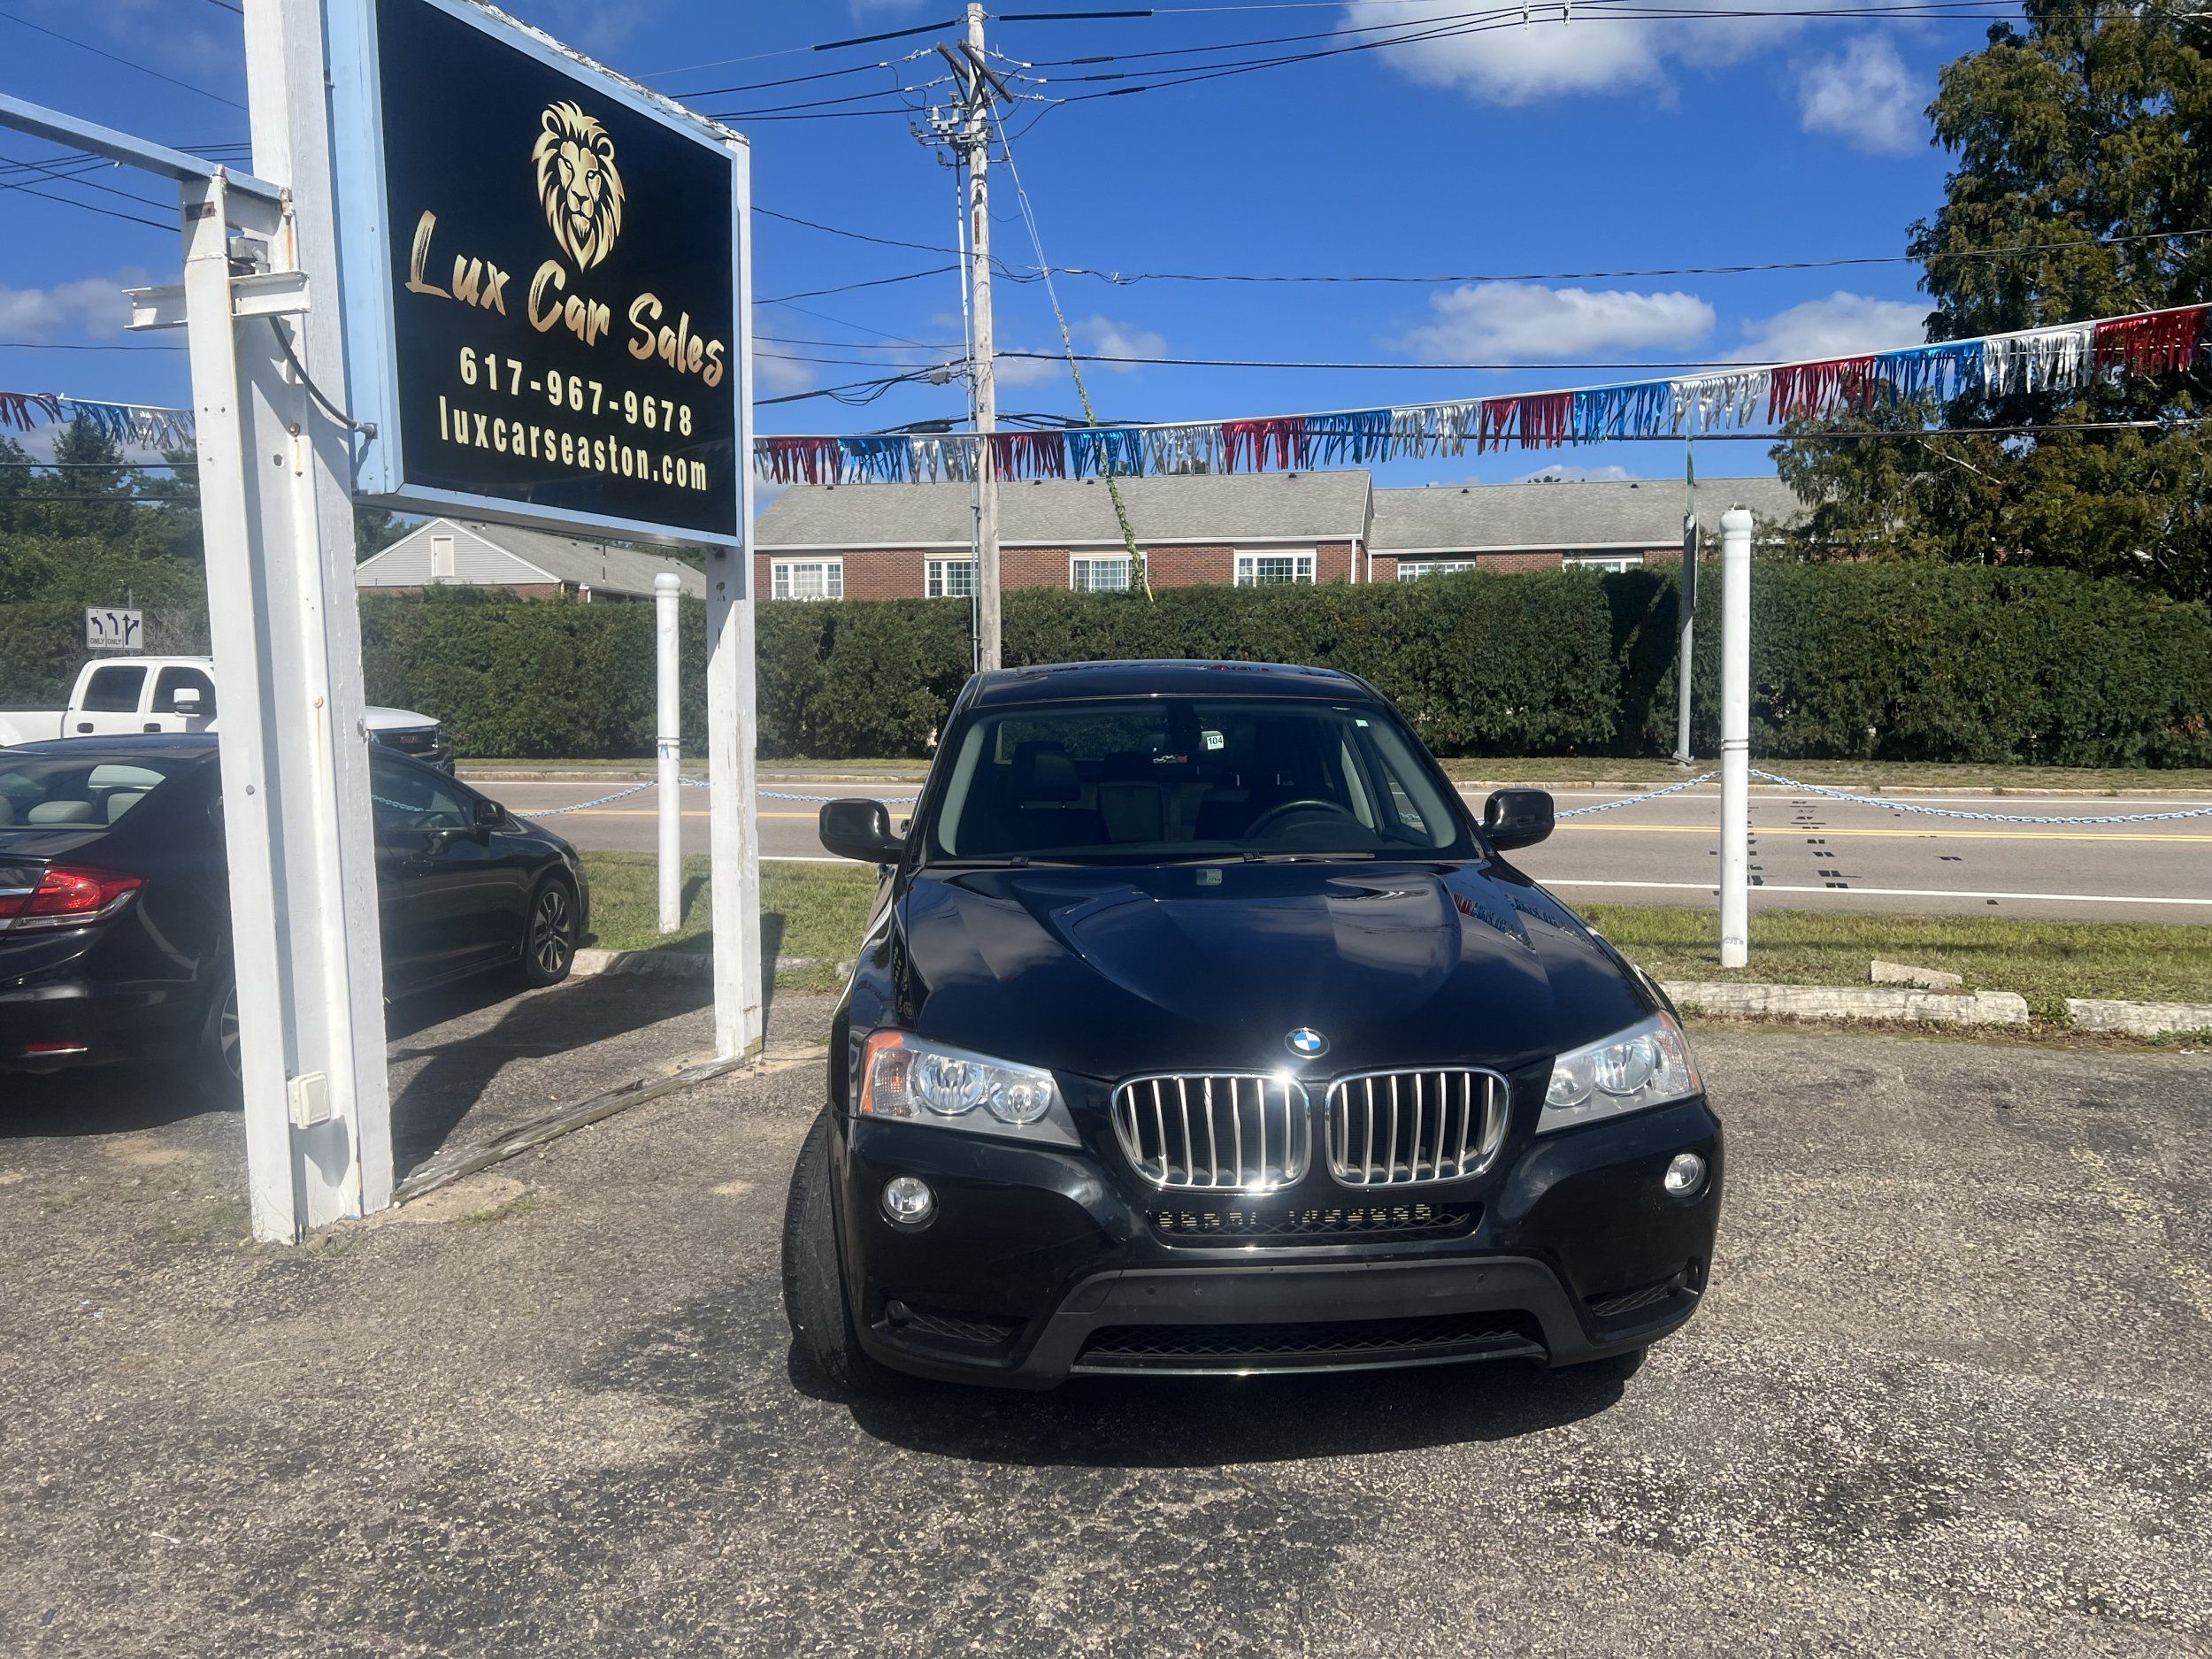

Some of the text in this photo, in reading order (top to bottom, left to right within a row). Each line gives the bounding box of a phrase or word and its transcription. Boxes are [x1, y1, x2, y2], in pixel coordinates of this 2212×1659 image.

[405, 210, 725, 388] Lux Car Sales
[459, 346, 692, 436] 617-967-9678
[439, 395, 707, 491] luxcarseaston.com
[1208, 736, 1223, 745] 104
